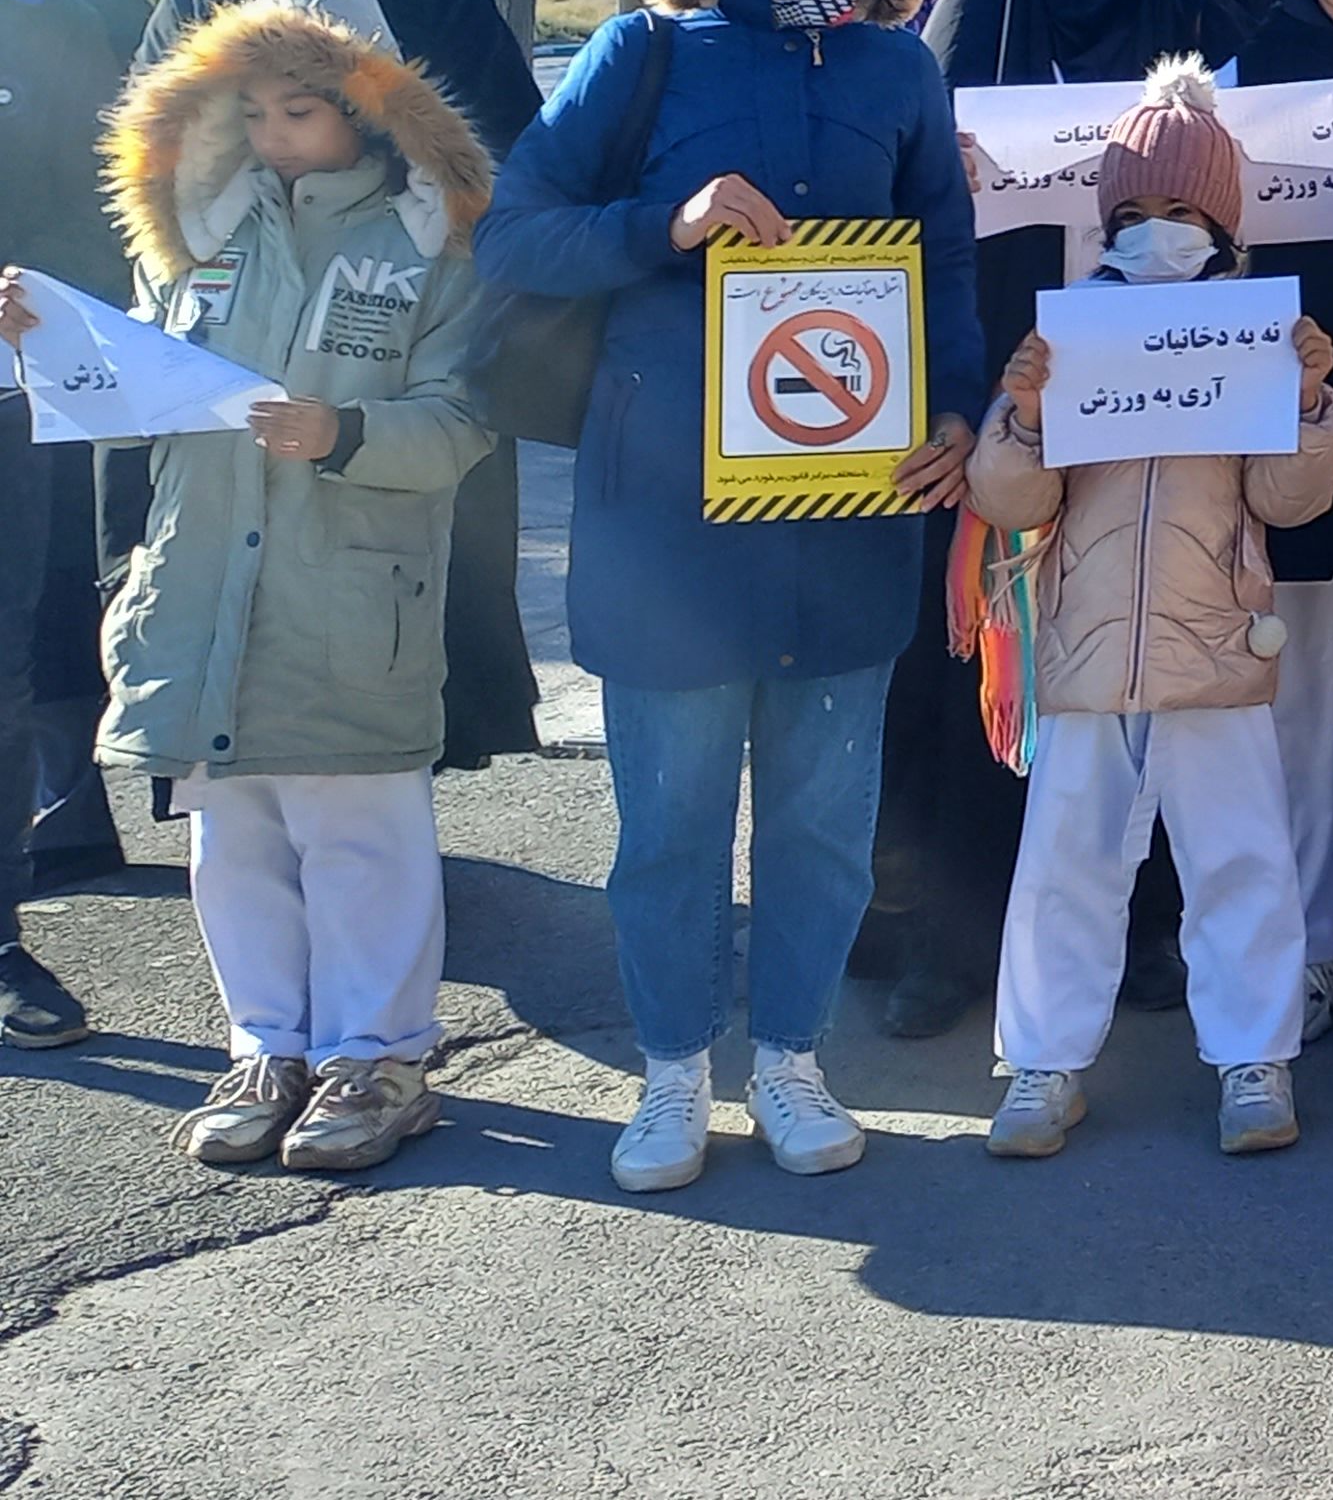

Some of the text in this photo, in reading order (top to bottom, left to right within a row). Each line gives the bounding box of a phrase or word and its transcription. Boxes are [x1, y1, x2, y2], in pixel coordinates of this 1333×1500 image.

[1053, 123, 1113, 147] خانیات
[1057, 169, 1076, 187] به
[1257, 175, 1318, 202] ورزش
[304, 252, 427, 352] NK
[330, 285, 415, 314] FASHION
[759, 276, 803, 312] ممنوع
[319, 338, 403, 363] SCOOP
[1143, 320, 1281, 357] نه به دخانیات
[62, 364, 118, 392] رزش
[1080, 375, 1227, 416] آری به ورزش
